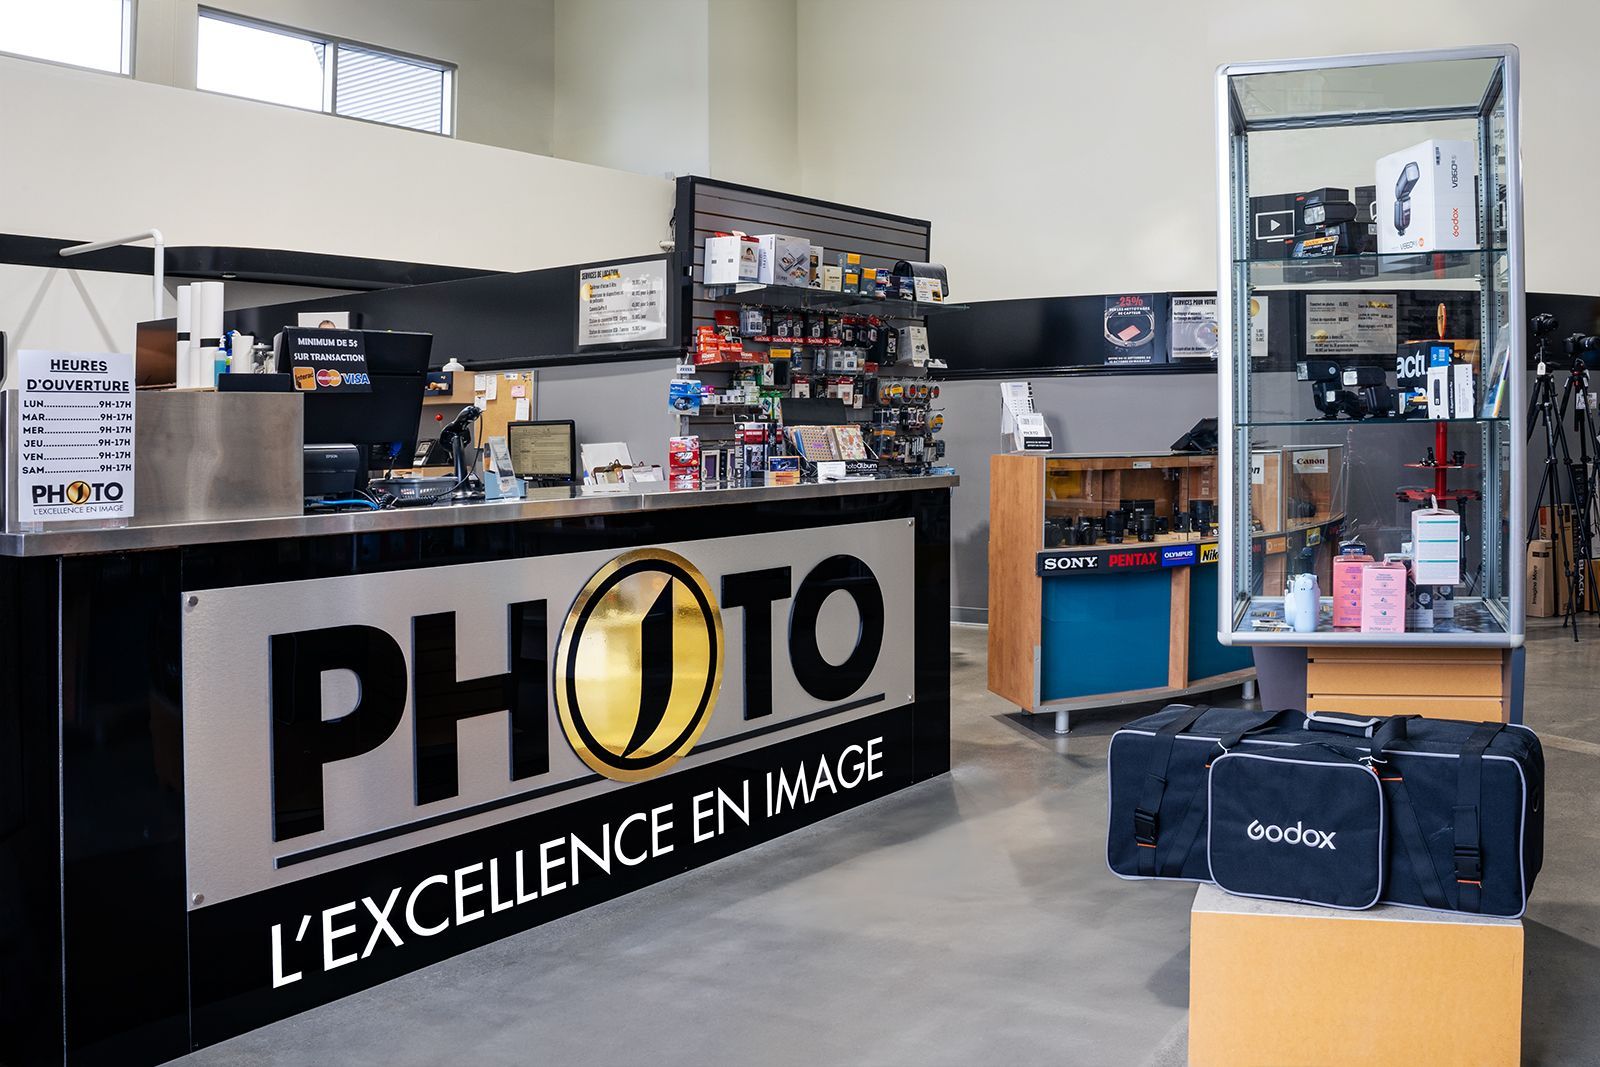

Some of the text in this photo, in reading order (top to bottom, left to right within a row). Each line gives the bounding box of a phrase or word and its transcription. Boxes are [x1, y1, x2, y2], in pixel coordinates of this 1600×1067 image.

[1451, 207, 1459, 238] Godox
[1116, 295, 1144, 307] -25%
[298, 338, 358, 348] MINIMUM DE 5$
[294, 352, 364, 362] SUR TRANSACTION
[50, 359, 108, 371] HEURES
[342, 373, 370, 384] VISA
[26, 379, 130, 392] D'OUVERTURE
[32, 481, 124, 504] PHOTO
[33, 506, 84, 516] L'EXCELLENCE
[99, 504, 124, 512] IMAGE
[1108, 552, 1158, 568] PENTAX
[1164, 550, 1194, 559] OLYMPUS
[1202, 549, 1219, 561] Nik
[1044, 557, 1098, 570] SONY
[268, 547, 885, 842] PHOTO
[1247, 819, 1337, 851] Godox
[271, 736, 884, 990] L'EXCELLENCE EN IMAGE
